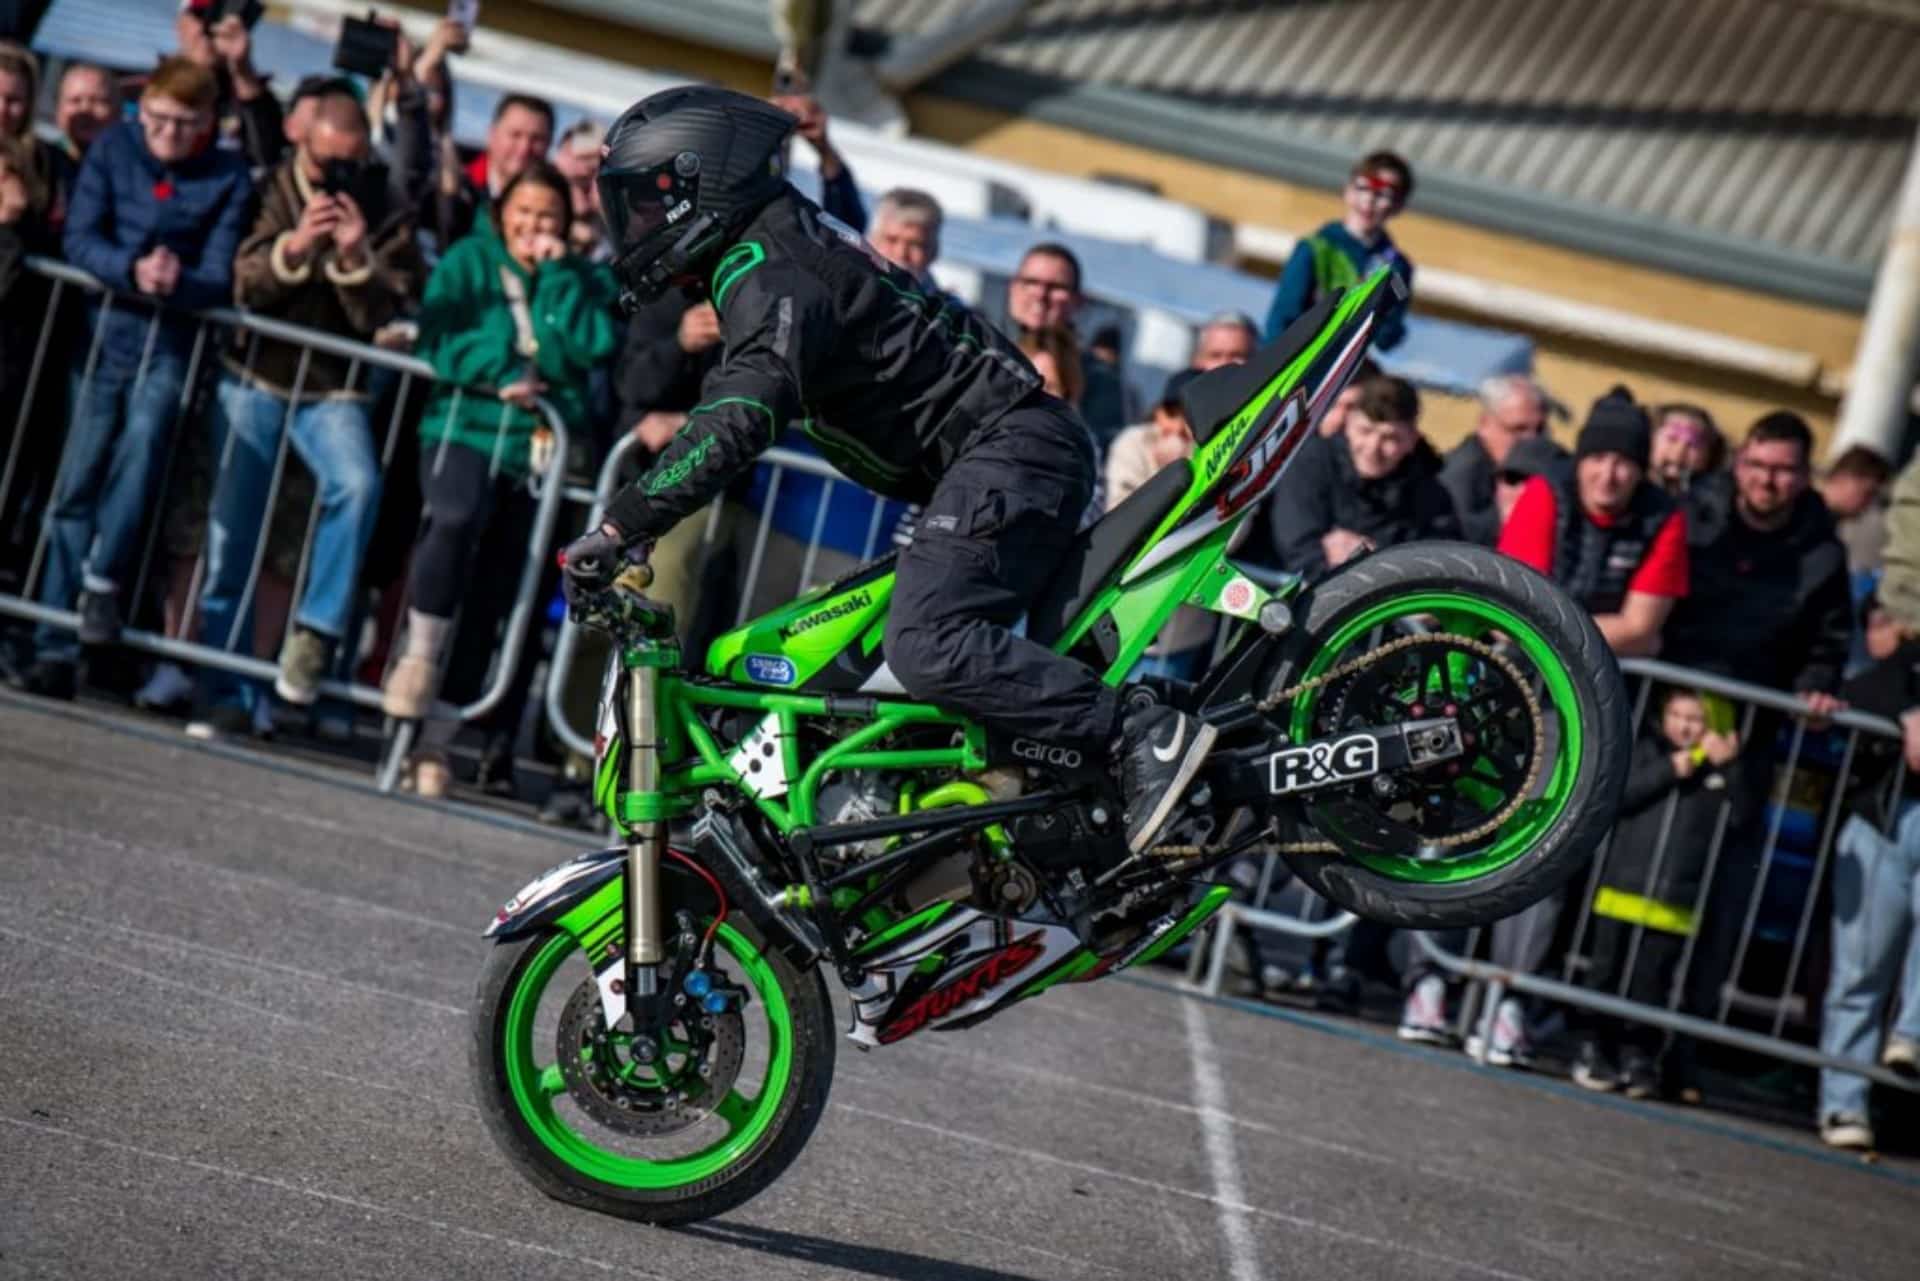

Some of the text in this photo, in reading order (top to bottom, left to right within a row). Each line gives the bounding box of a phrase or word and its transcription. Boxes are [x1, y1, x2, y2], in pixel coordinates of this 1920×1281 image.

[1206, 415, 1250, 481] Ninja
[778, 589, 873, 642] Kawasaki
[1270, 734, 1378, 794] R&G
[877, 928, 1047, 1045] STUNTS
